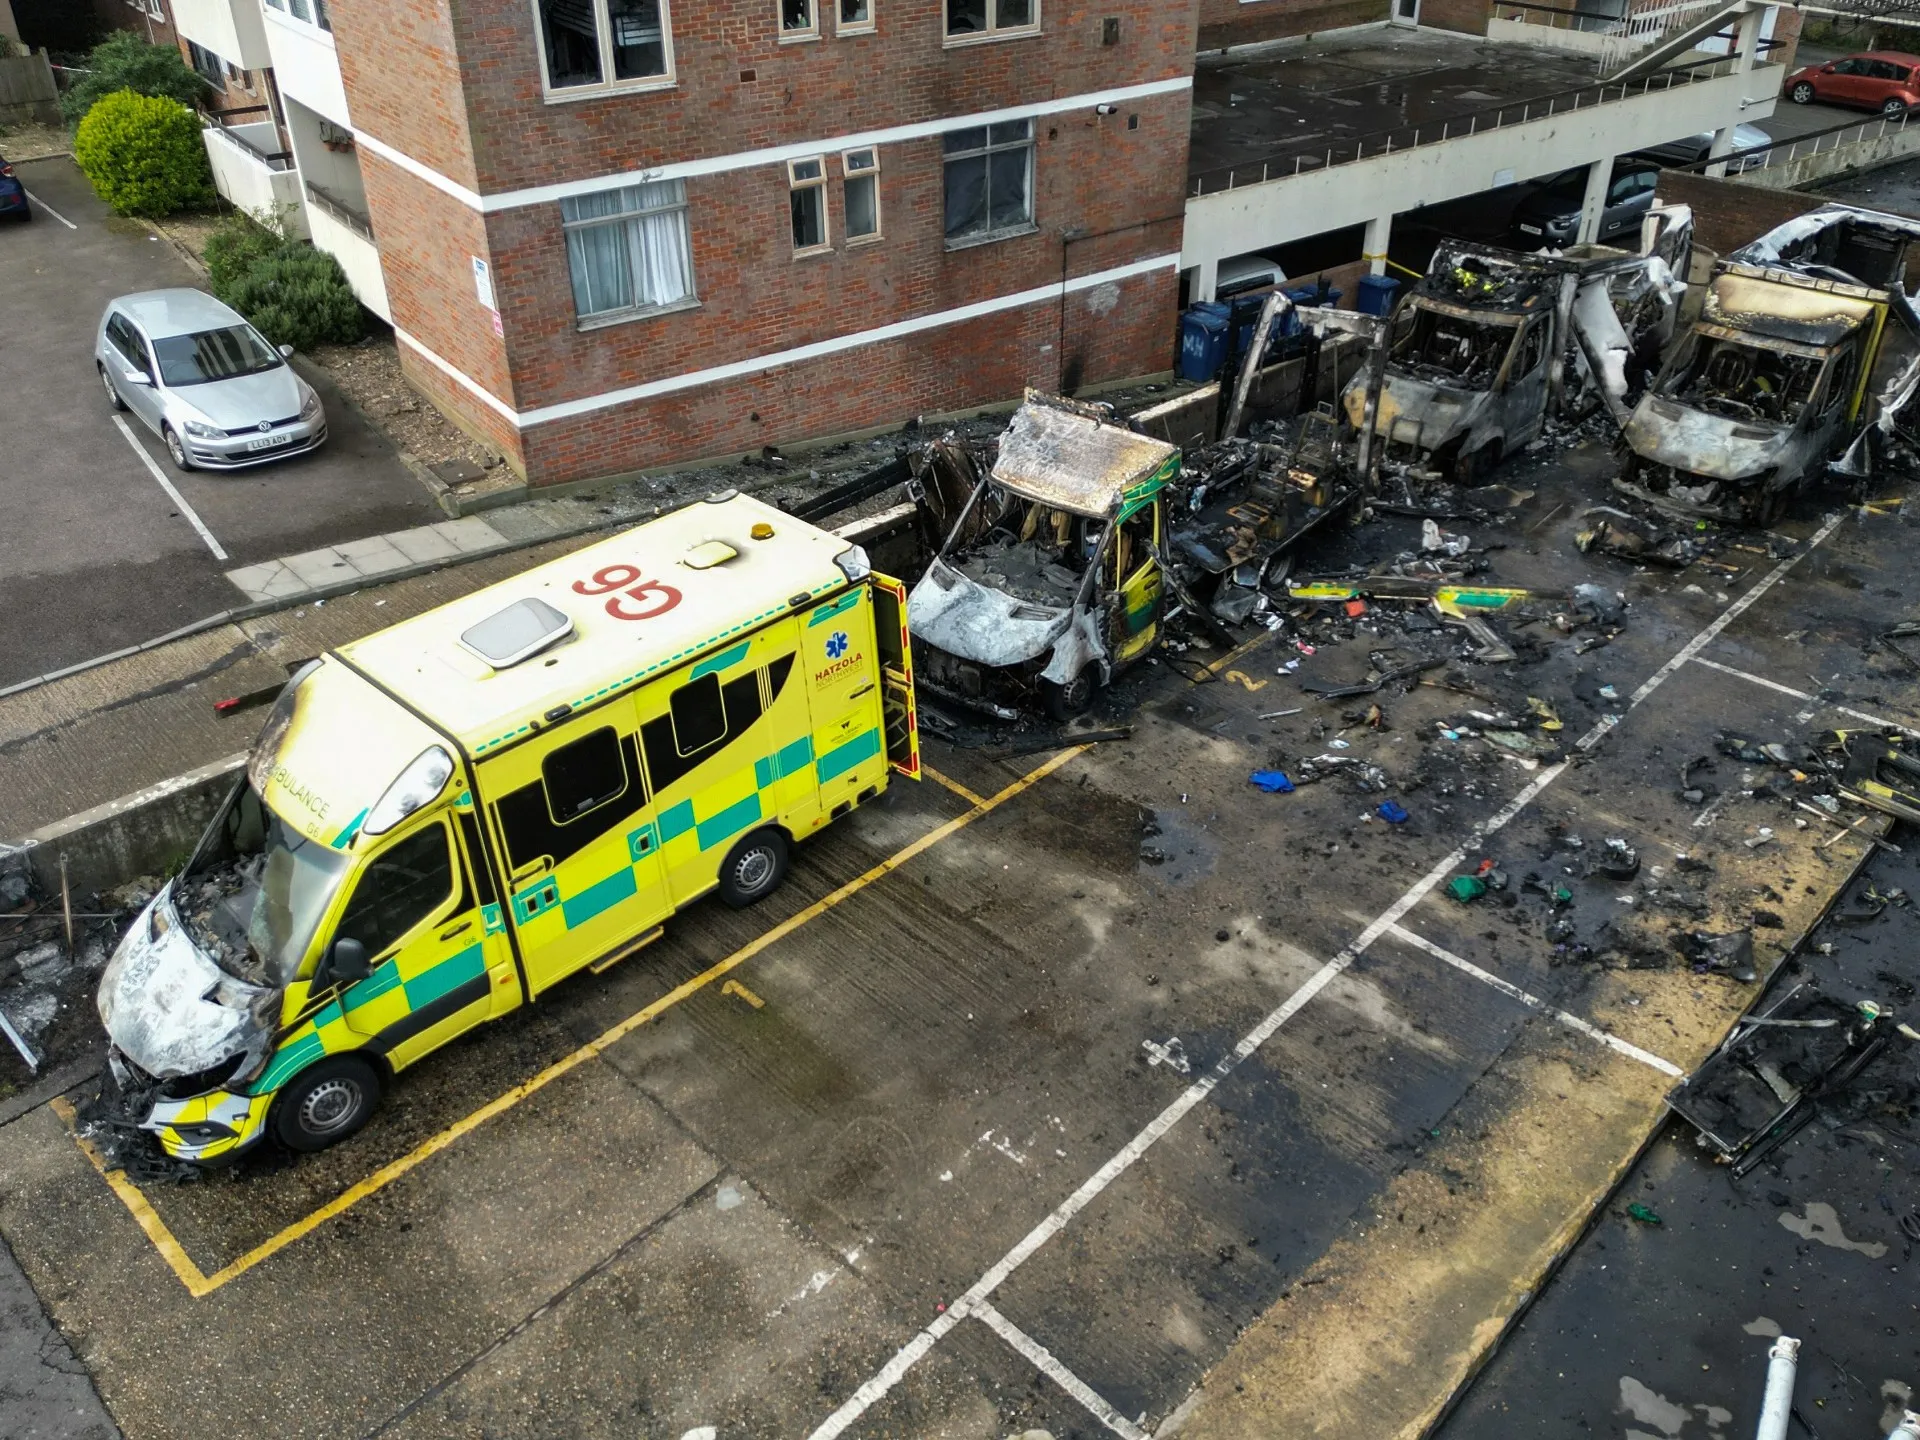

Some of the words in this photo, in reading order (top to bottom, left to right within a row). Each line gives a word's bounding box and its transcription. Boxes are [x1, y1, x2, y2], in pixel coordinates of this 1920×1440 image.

[815, 652, 863, 682] HATZOLA
[1225, 670, 1269, 692] 2
[271, 764, 331, 820] BULANCE
[306, 822, 320, 838] G6
[721, 979, 766, 1009] 1
